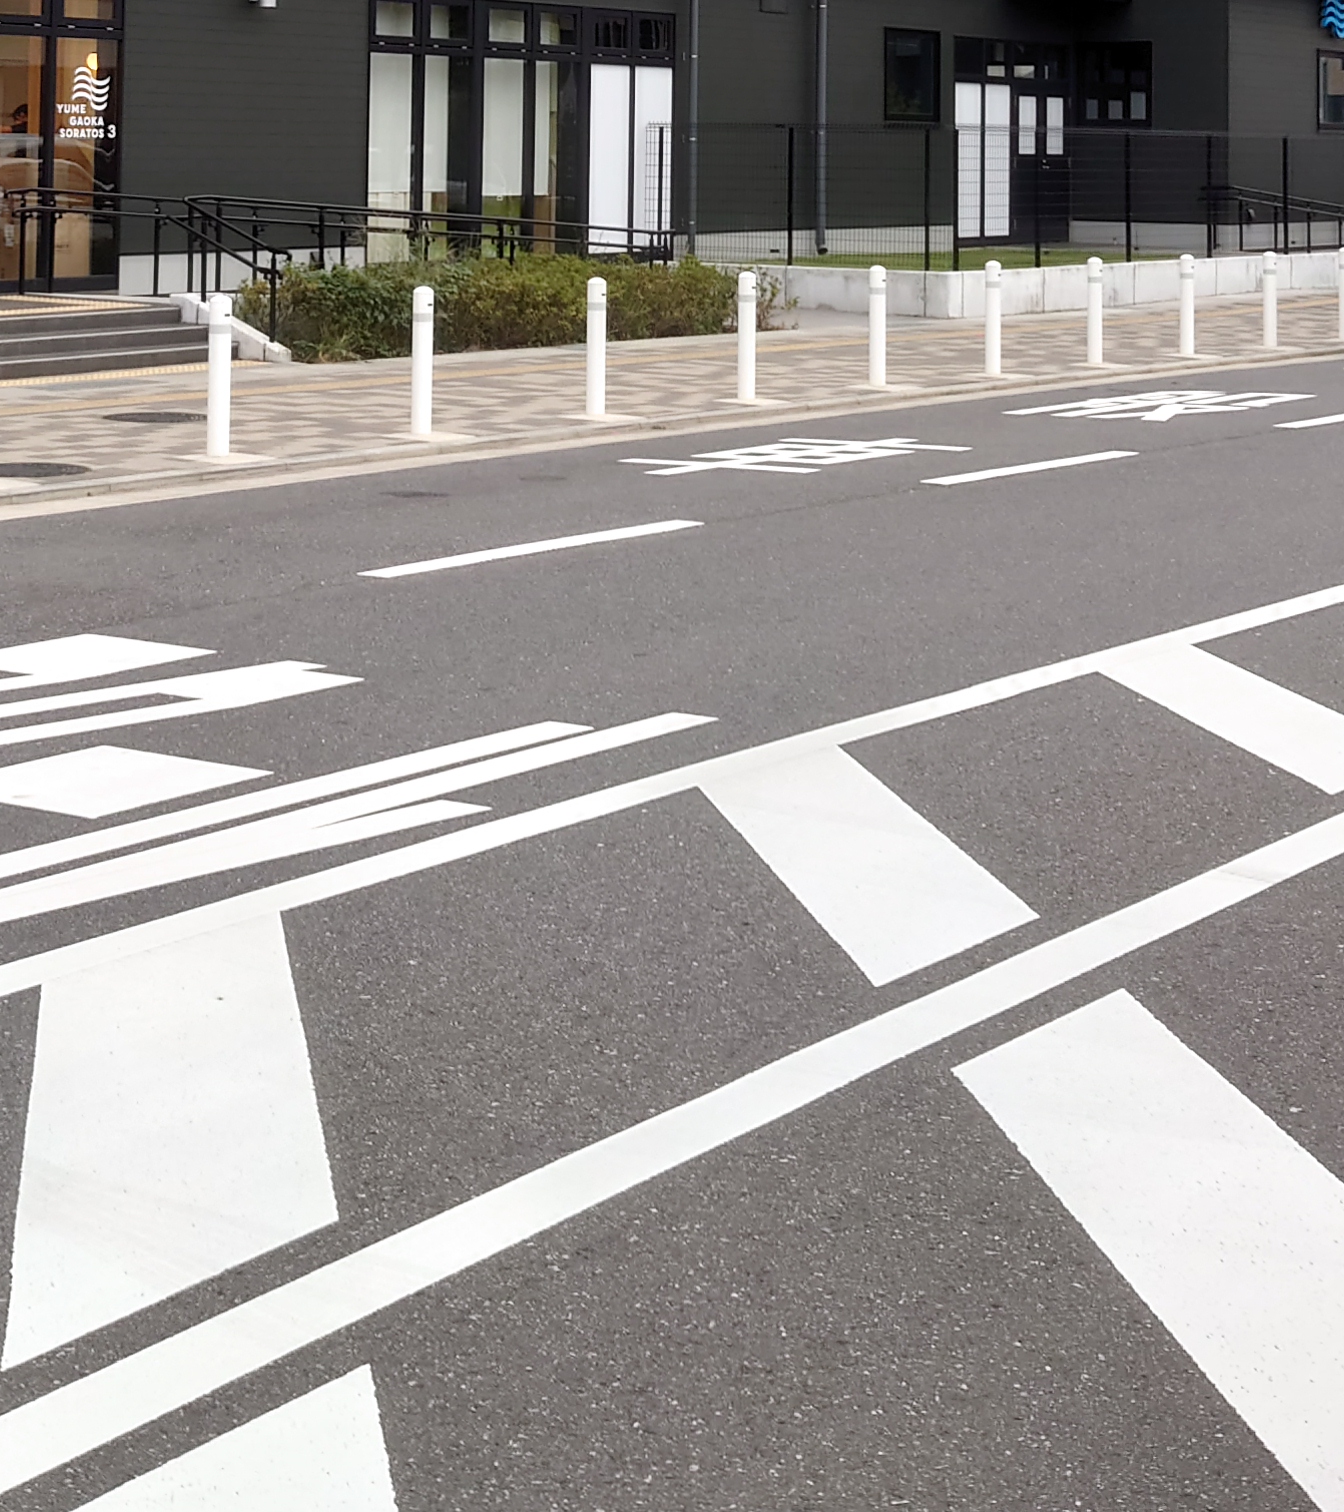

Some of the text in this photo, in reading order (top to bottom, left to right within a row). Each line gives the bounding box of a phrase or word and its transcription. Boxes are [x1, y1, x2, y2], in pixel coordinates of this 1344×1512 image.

[56, 103, 87, 114] YUME
[69, 116, 104, 126] GAOKA
[59, 124, 116, 139] SORATOS 3
